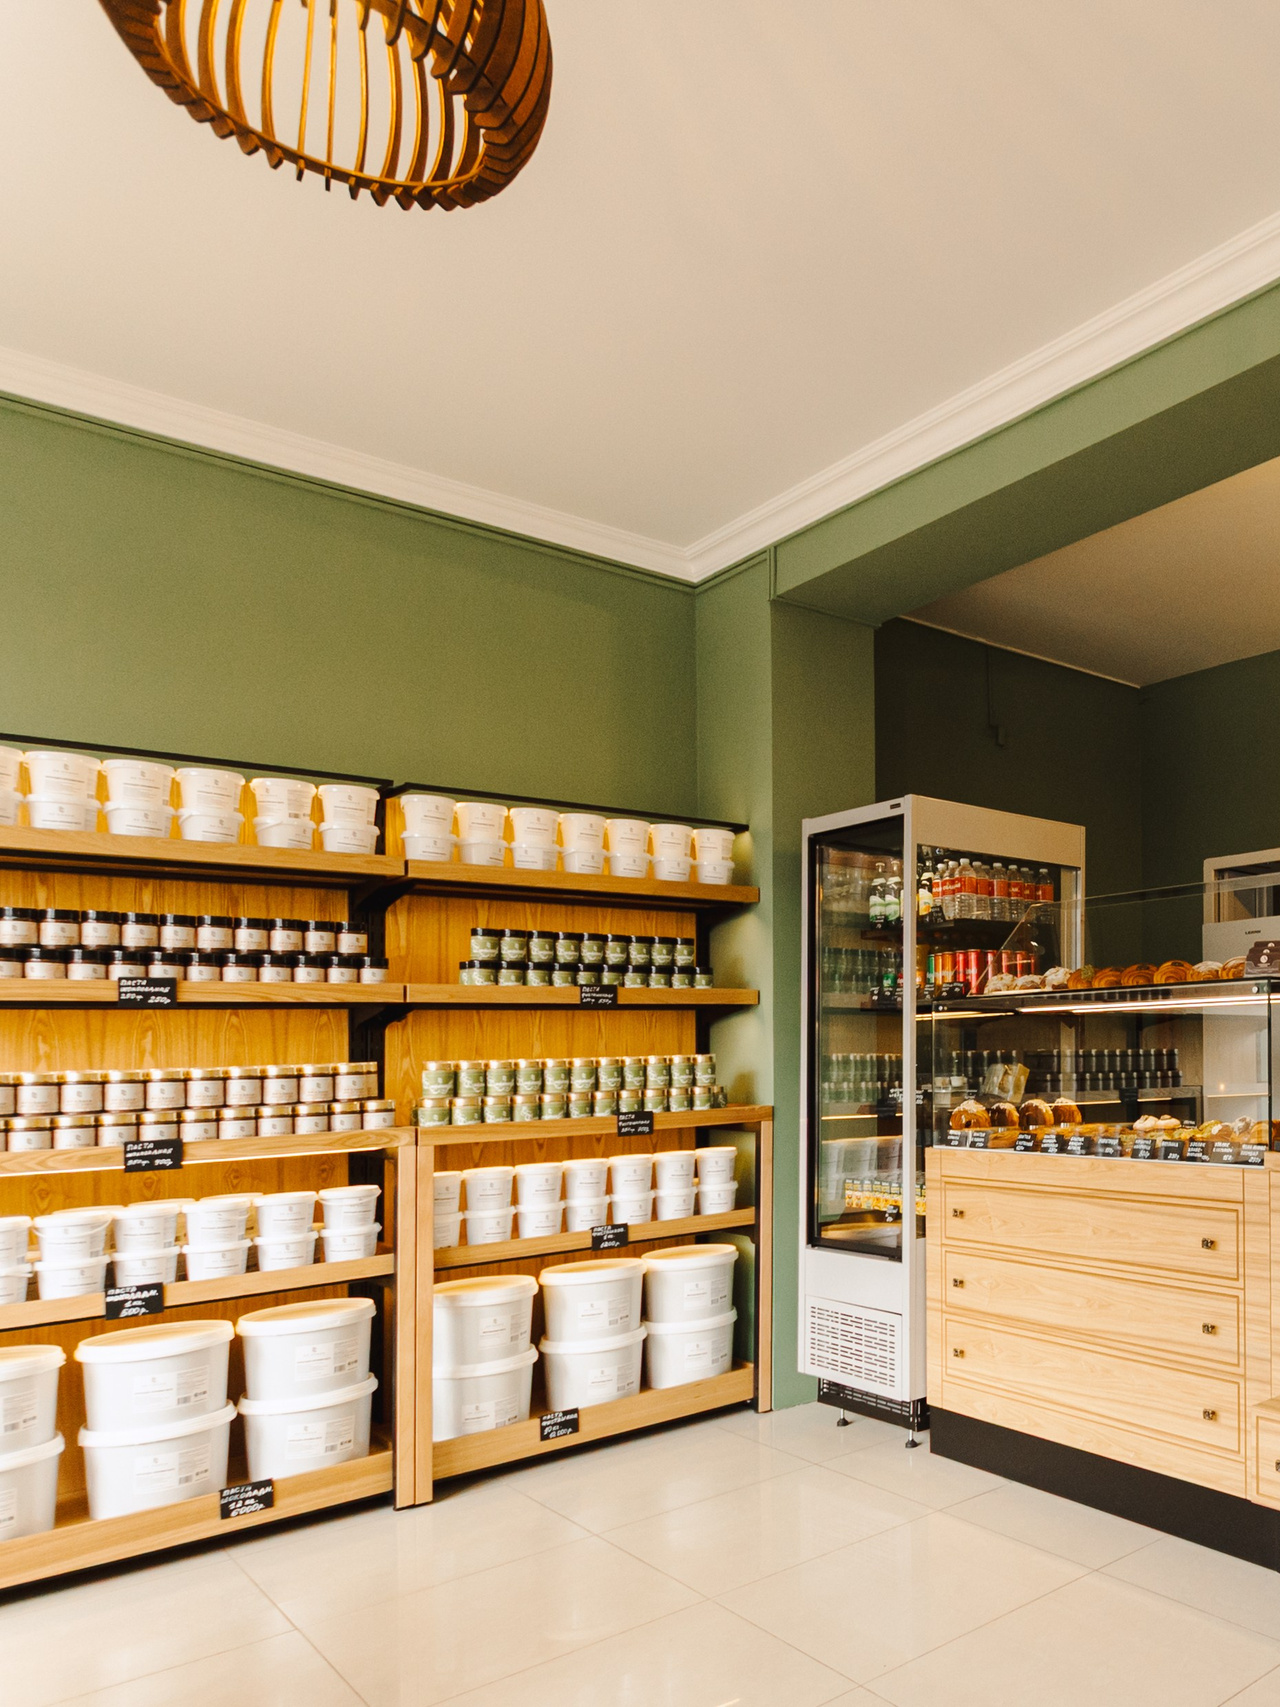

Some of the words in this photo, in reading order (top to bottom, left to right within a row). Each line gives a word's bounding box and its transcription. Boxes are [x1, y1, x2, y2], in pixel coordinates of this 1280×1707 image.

[126, 1142, 154, 1151] ПАСТА
[107, 1286, 137, 1295] ПАСТА
[222, 1485, 252, 1497] ПАСТА
